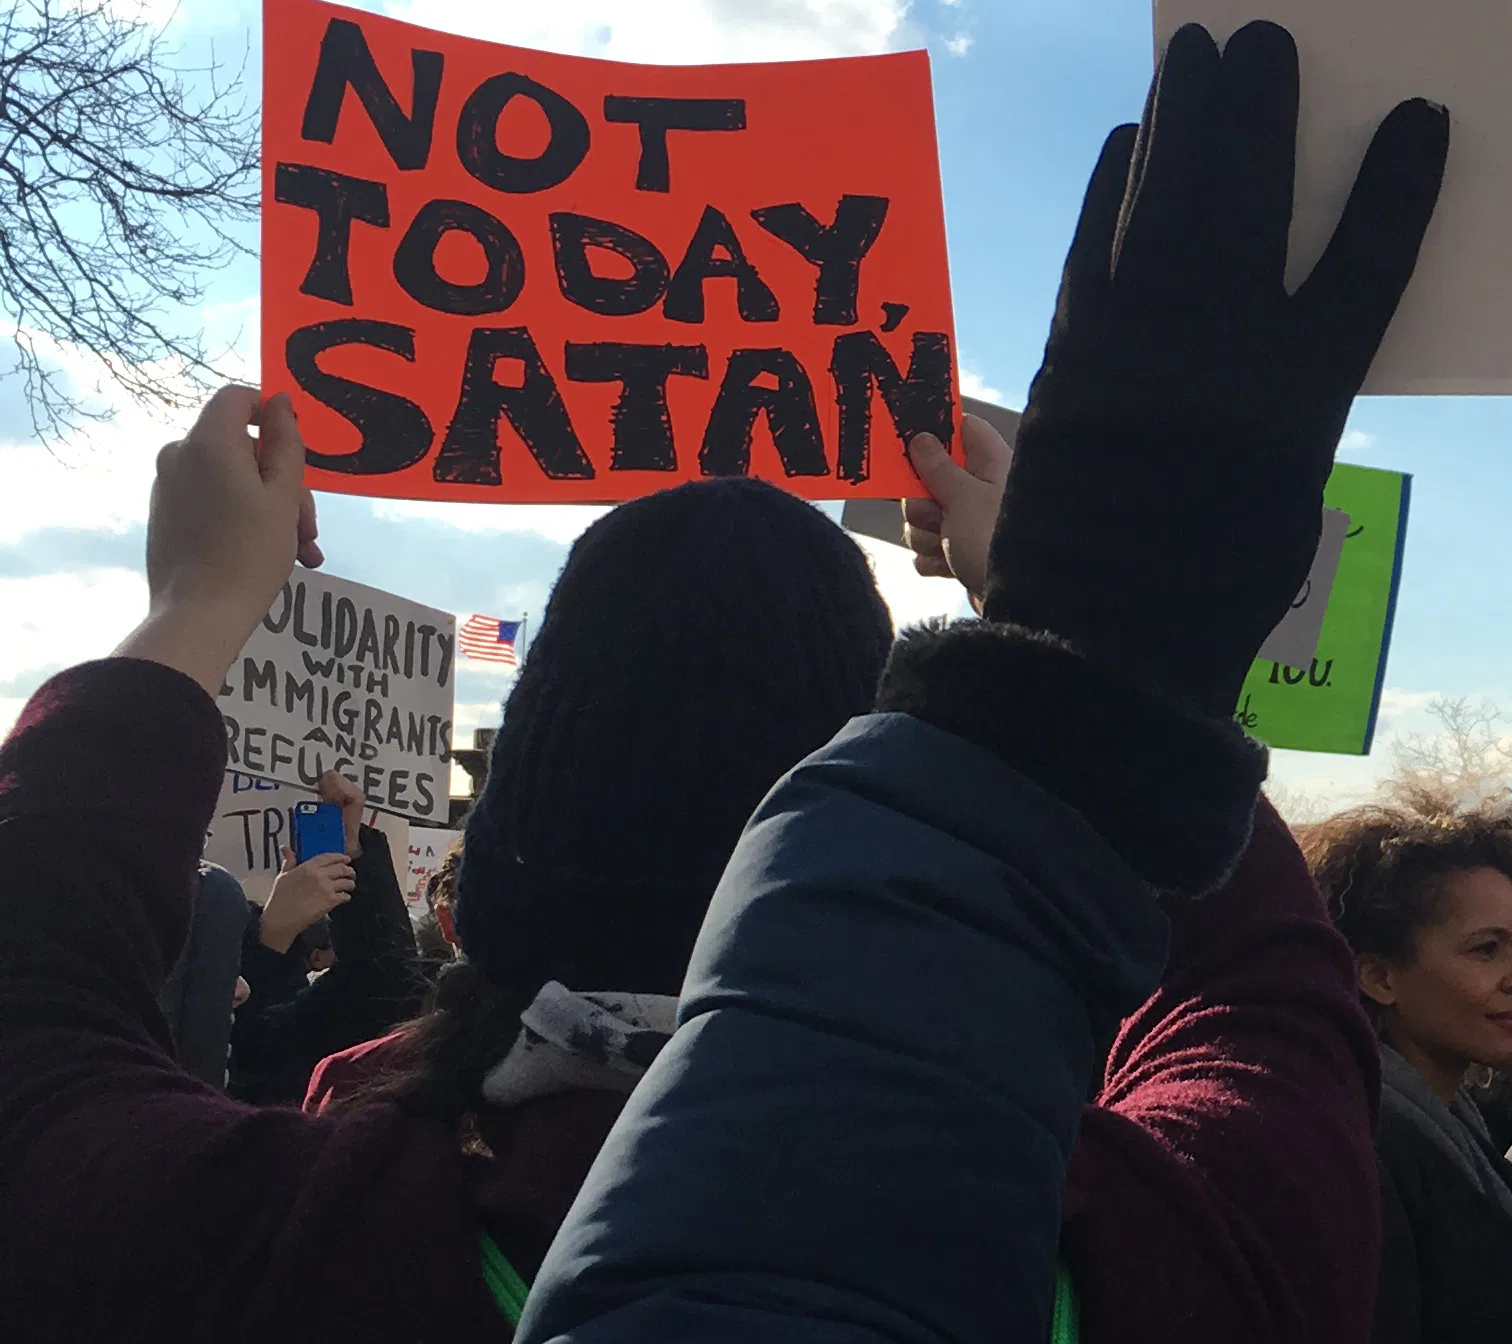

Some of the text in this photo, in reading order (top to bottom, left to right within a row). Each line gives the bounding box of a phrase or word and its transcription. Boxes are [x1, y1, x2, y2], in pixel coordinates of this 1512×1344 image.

[301, 17, 746, 193] NOT
[274, 161, 910, 332] TODAY,
[285, 318, 954, 485] SATAN
[262, 581, 454, 688] OLIDARITY
[302, 650, 389, 697] WITH
[222, 715, 435, 815] REFUGEES
[303, 727, 379, 761] AND
[222, 807, 295, 872] TR
